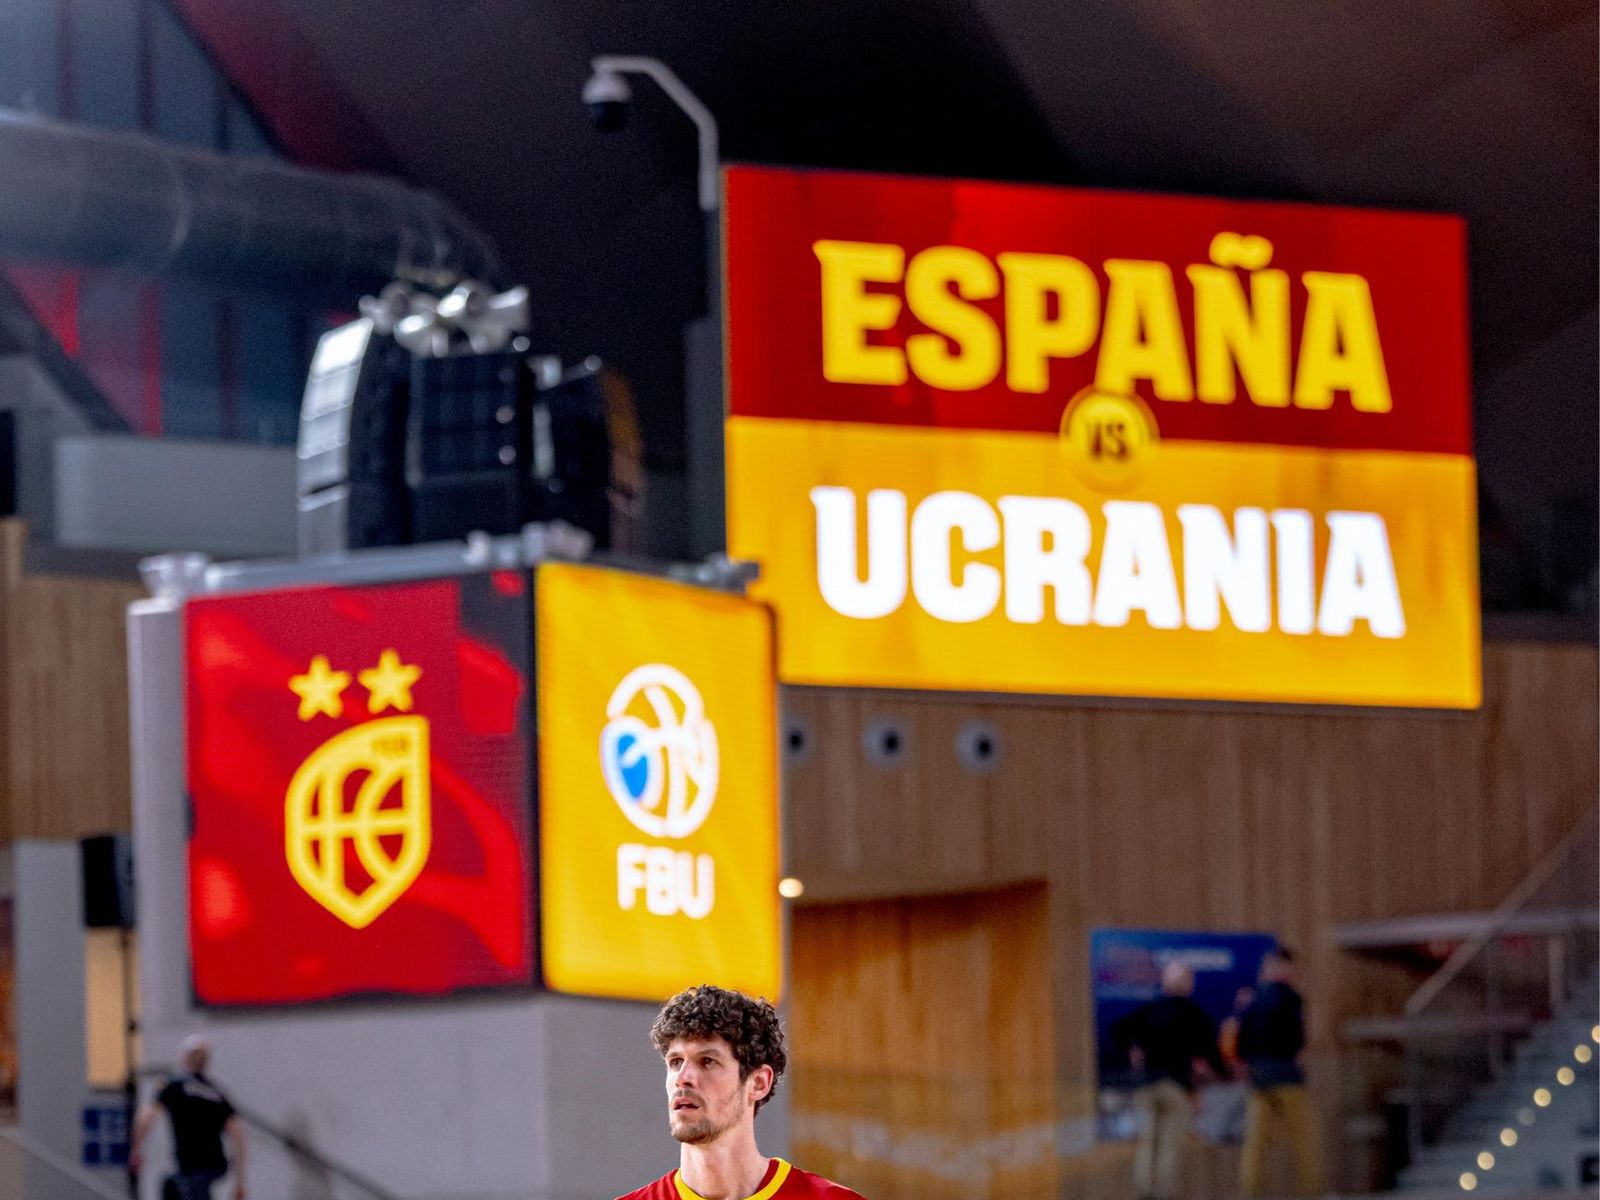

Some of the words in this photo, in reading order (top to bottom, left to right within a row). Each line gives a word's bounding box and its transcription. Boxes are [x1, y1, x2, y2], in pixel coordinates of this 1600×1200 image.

[812, 232, 1393, 413] ESPAÑA
[810, 486, 1406, 640] UCRANIA
[617, 843, 714, 920] FBU
